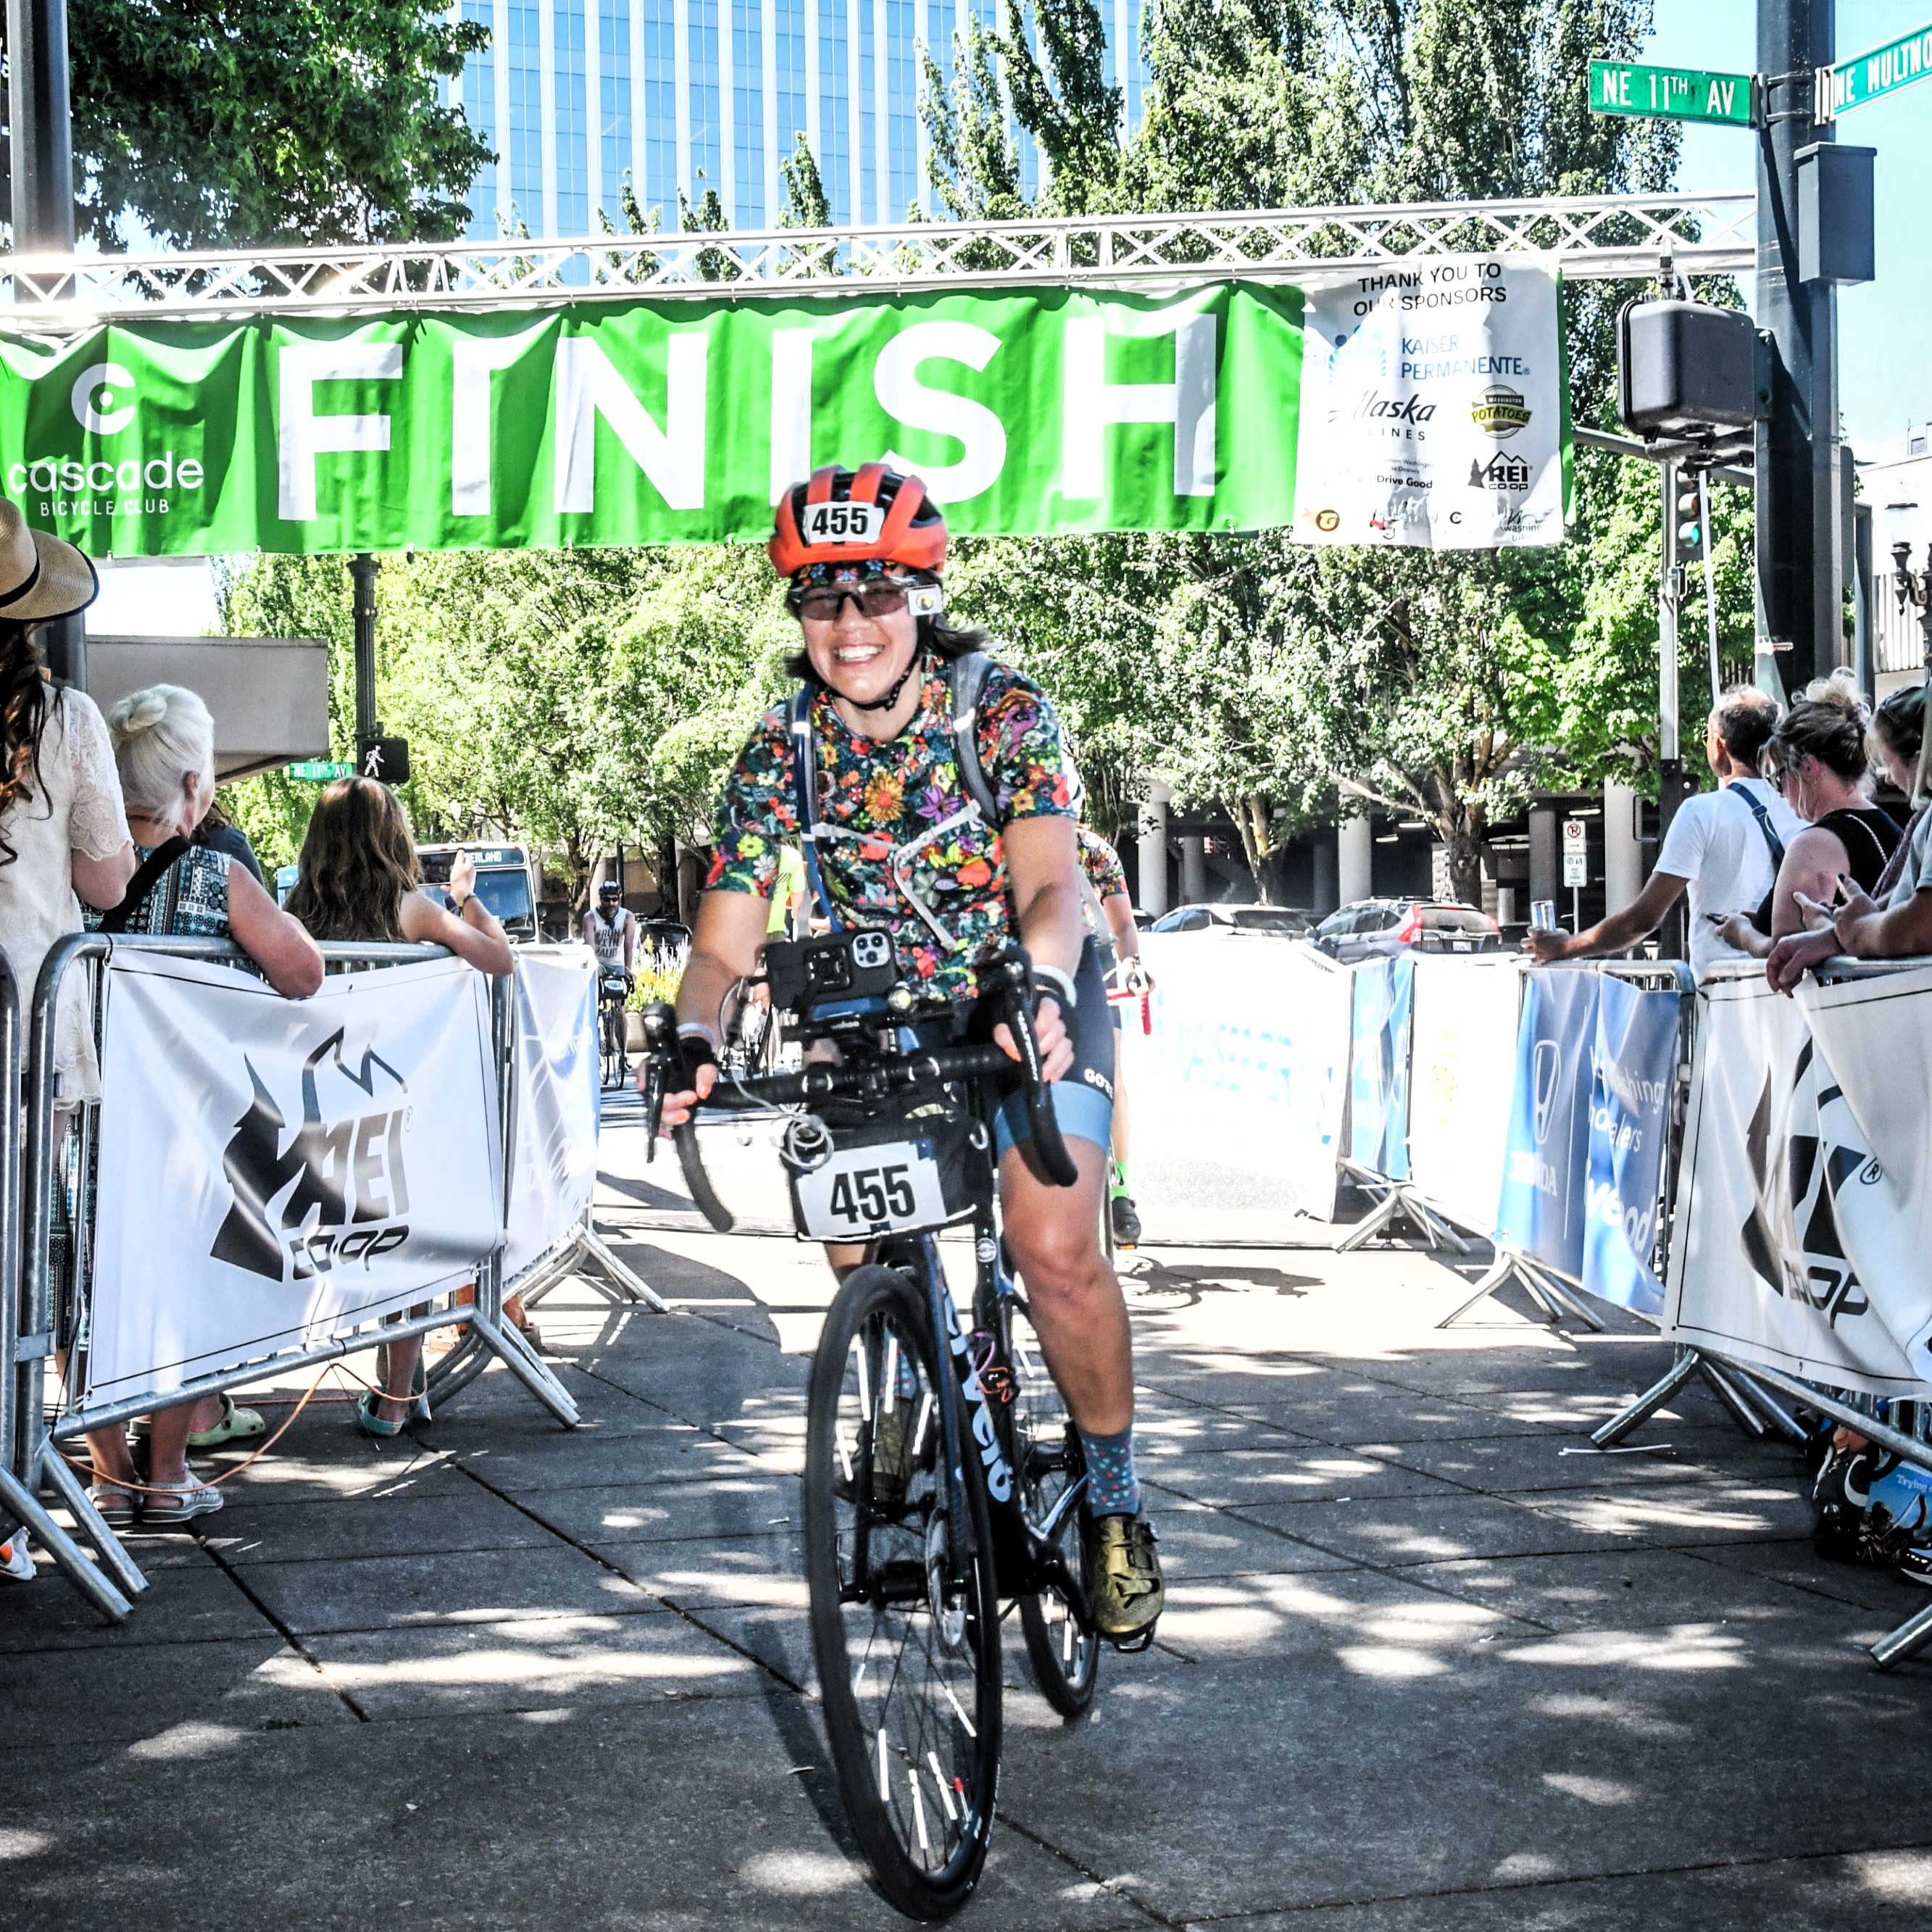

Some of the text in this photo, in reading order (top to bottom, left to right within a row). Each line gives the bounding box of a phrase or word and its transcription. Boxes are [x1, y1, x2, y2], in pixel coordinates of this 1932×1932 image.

[1603, 69, 1736, 116] NE 11TH AV
[1833, 67, 1856, 108] NE
[1357, 262, 1502, 293] THANK YOU TO
[1401, 286, 1507, 311] SPONSORS
[1402, 335, 1459, 355] KAISER
[278, 313, 1217, 522] FINISH
[1471, 406, 1531, 423] POTATOES
[9, 450, 204, 494] cascade
[1377, 475, 1433, 488] Drive Good
[1488, 465, 1528, 483] REI
[41, 499, 170, 517] BICYCLE CLUB
[811, 507, 869, 536] 455
[293, 765, 306, 778] NE
[335, 764, 346, 778] AV
[470, 851, 502, 863] ERLAND
[830, 1162, 916, 1224] 455
